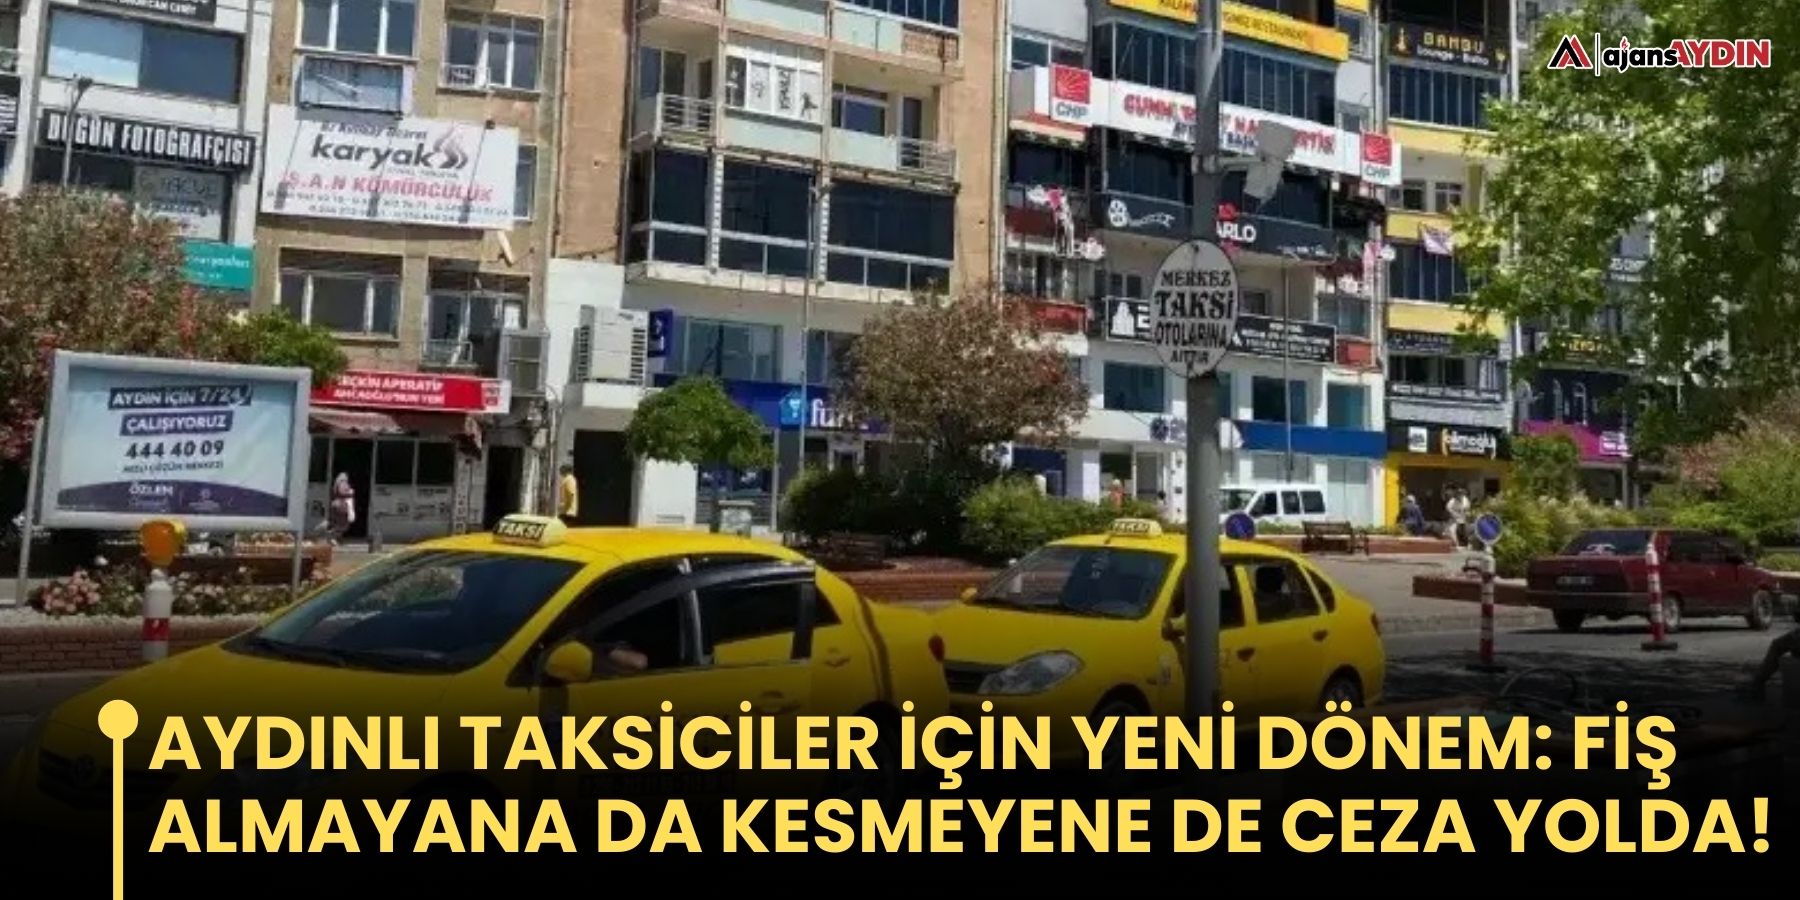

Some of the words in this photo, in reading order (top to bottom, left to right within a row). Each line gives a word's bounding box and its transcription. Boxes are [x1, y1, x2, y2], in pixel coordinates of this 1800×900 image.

[1424, 32, 1484, 54] BAMBU
[1056, 102, 1088, 118] CHP
[311, 133, 435, 170] karyak
[1161, 270, 1231, 287] MERKEZ
[1154, 290, 1234, 319] TAKSİ
[1154, 321, 1228, 348] OTOLARINA
[112, 391, 162, 406] AYDIN
[165, 388, 196, 407] İÇİN
[126, 414, 227, 434] ÇALIŞIYORUZ
[126, 442, 165, 460] 444
[171, 440, 196, 458] 40
[201, 440, 225, 457] 09
